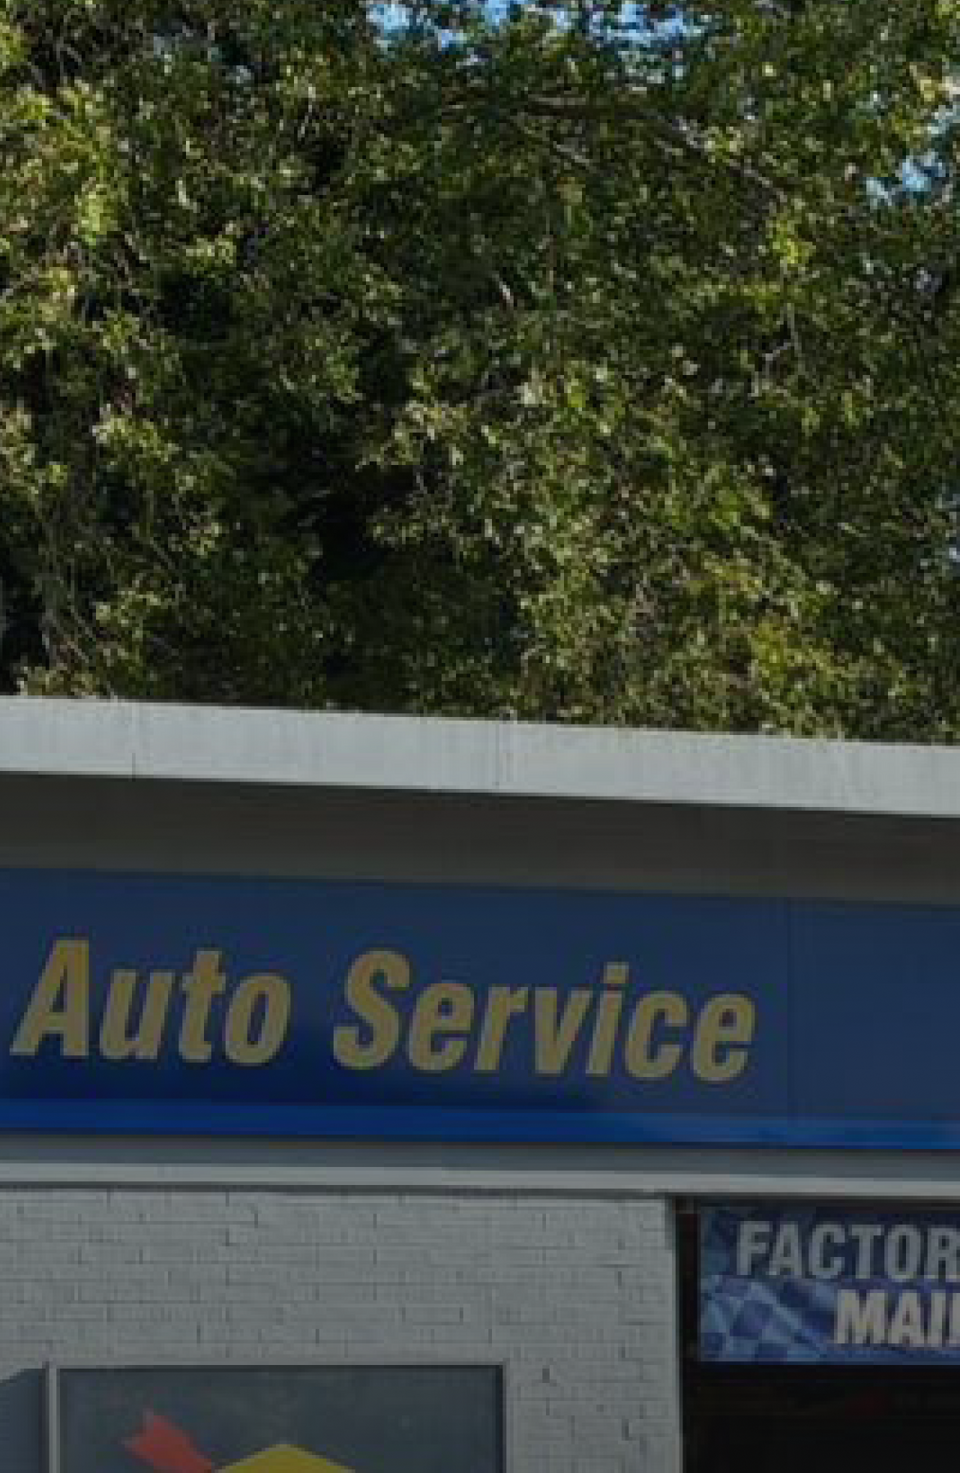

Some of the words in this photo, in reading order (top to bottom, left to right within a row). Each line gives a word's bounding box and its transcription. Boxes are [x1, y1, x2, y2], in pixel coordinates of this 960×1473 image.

[9, 938, 292, 1066] Auto
[332, 948, 757, 1082] Service
[737, 1219, 960, 1282] FACTOR
